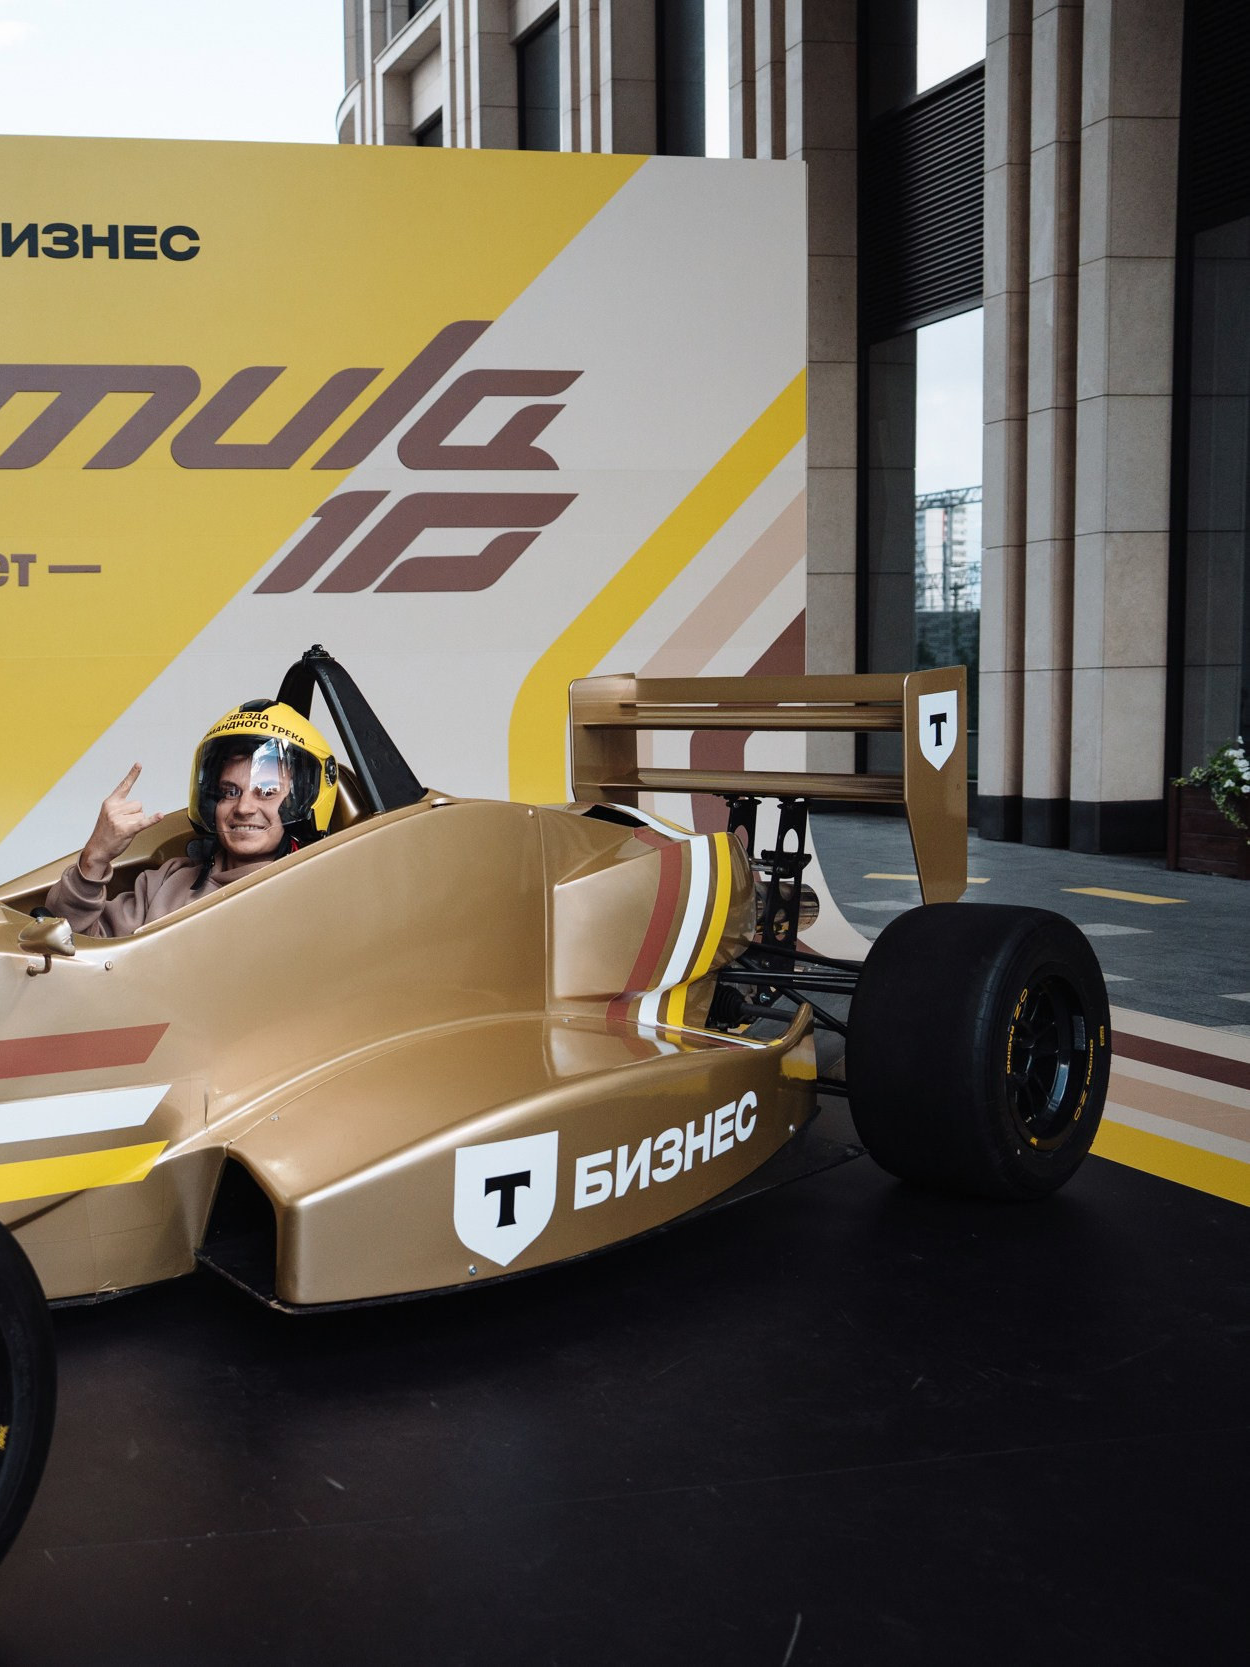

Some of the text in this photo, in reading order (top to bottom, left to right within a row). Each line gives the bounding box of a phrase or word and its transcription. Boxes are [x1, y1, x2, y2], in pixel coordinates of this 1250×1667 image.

[227, 712, 269, 721] ЗВЕЗДА
[929, 712, 947, 747] Т
[271, 723, 306, 746] ТРЕКА
[484, 1090, 758, 1229] Т БИЗНЕС
